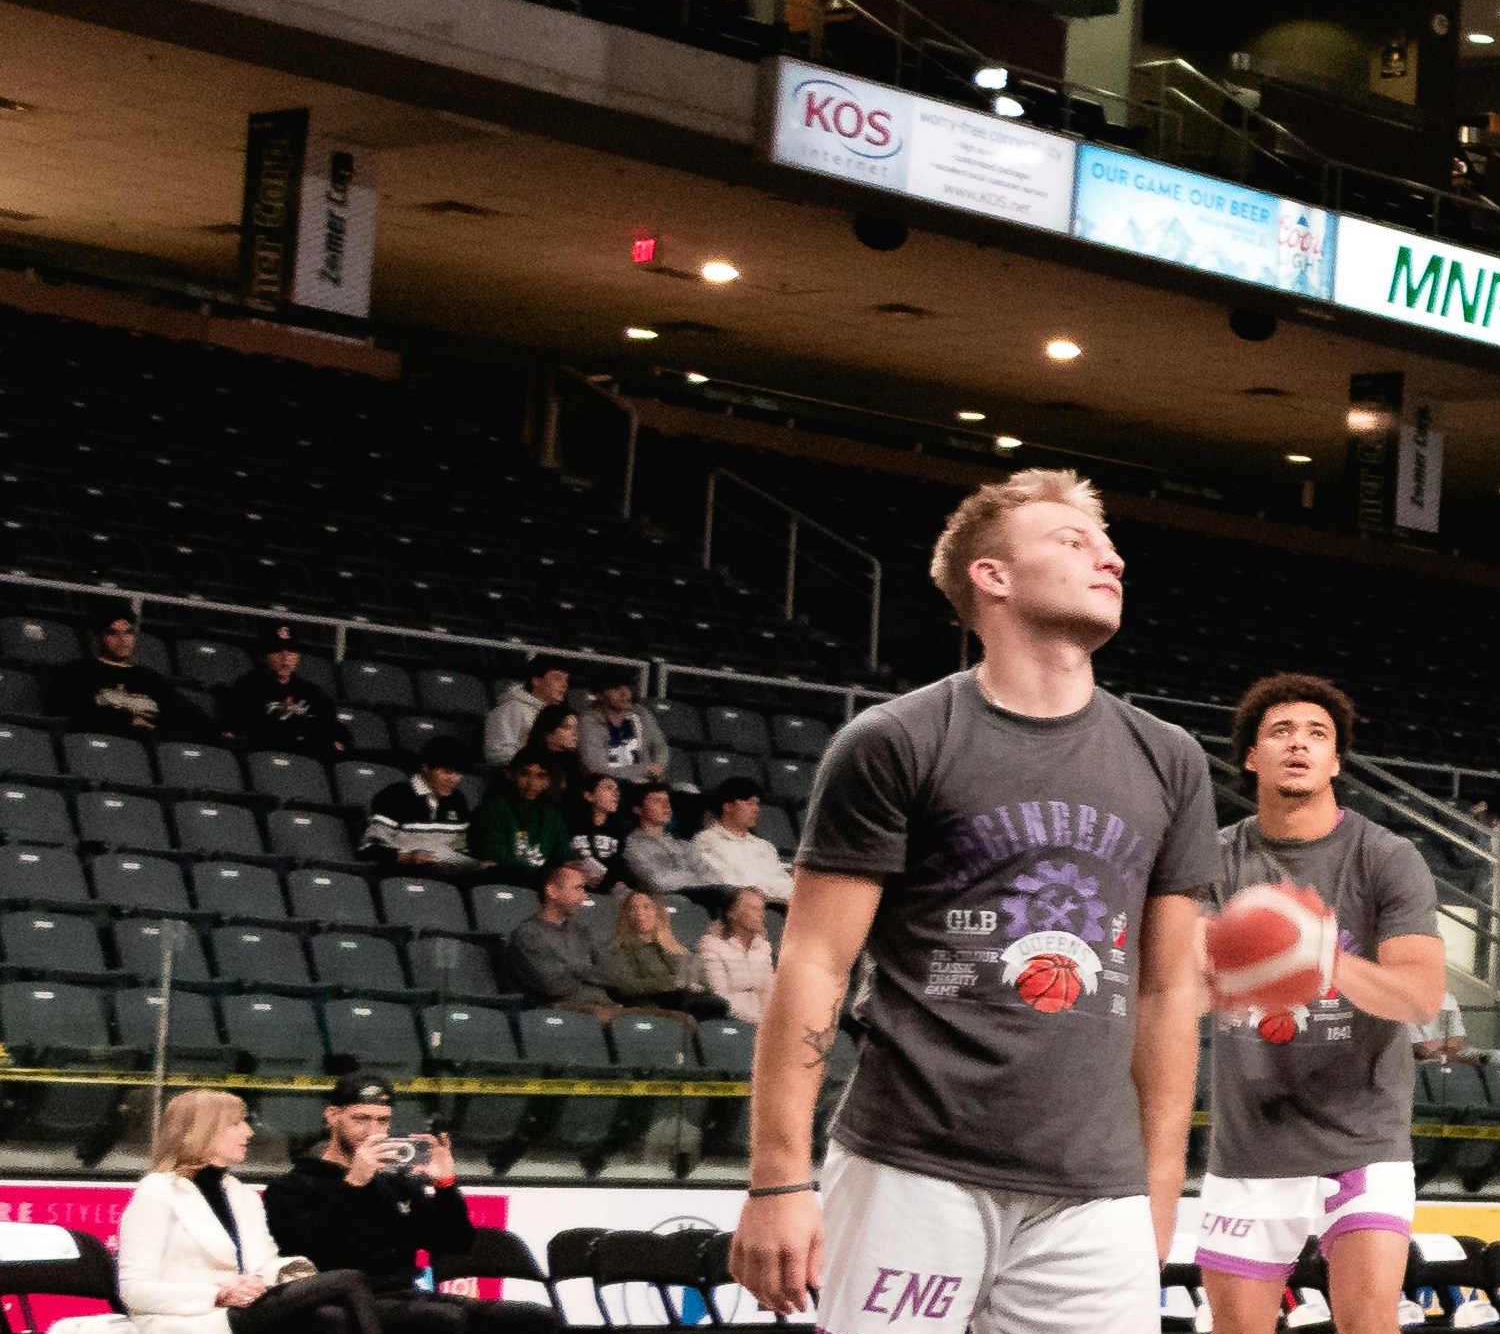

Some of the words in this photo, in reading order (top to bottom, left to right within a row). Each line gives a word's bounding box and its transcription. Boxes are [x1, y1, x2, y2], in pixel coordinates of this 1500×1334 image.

[801, 90, 893, 147] KOS
[793, 141, 890, 178] internet
[1091, 162, 1129, 186] OUR
[1189, 189, 1227, 212] OUR
[1230, 200, 1272, 225] BEER
[946, 909, 998, 931] GLB
[1018, 935, 1092, 963] QUEENS
[862, 1267, 962, 1323] ENG
